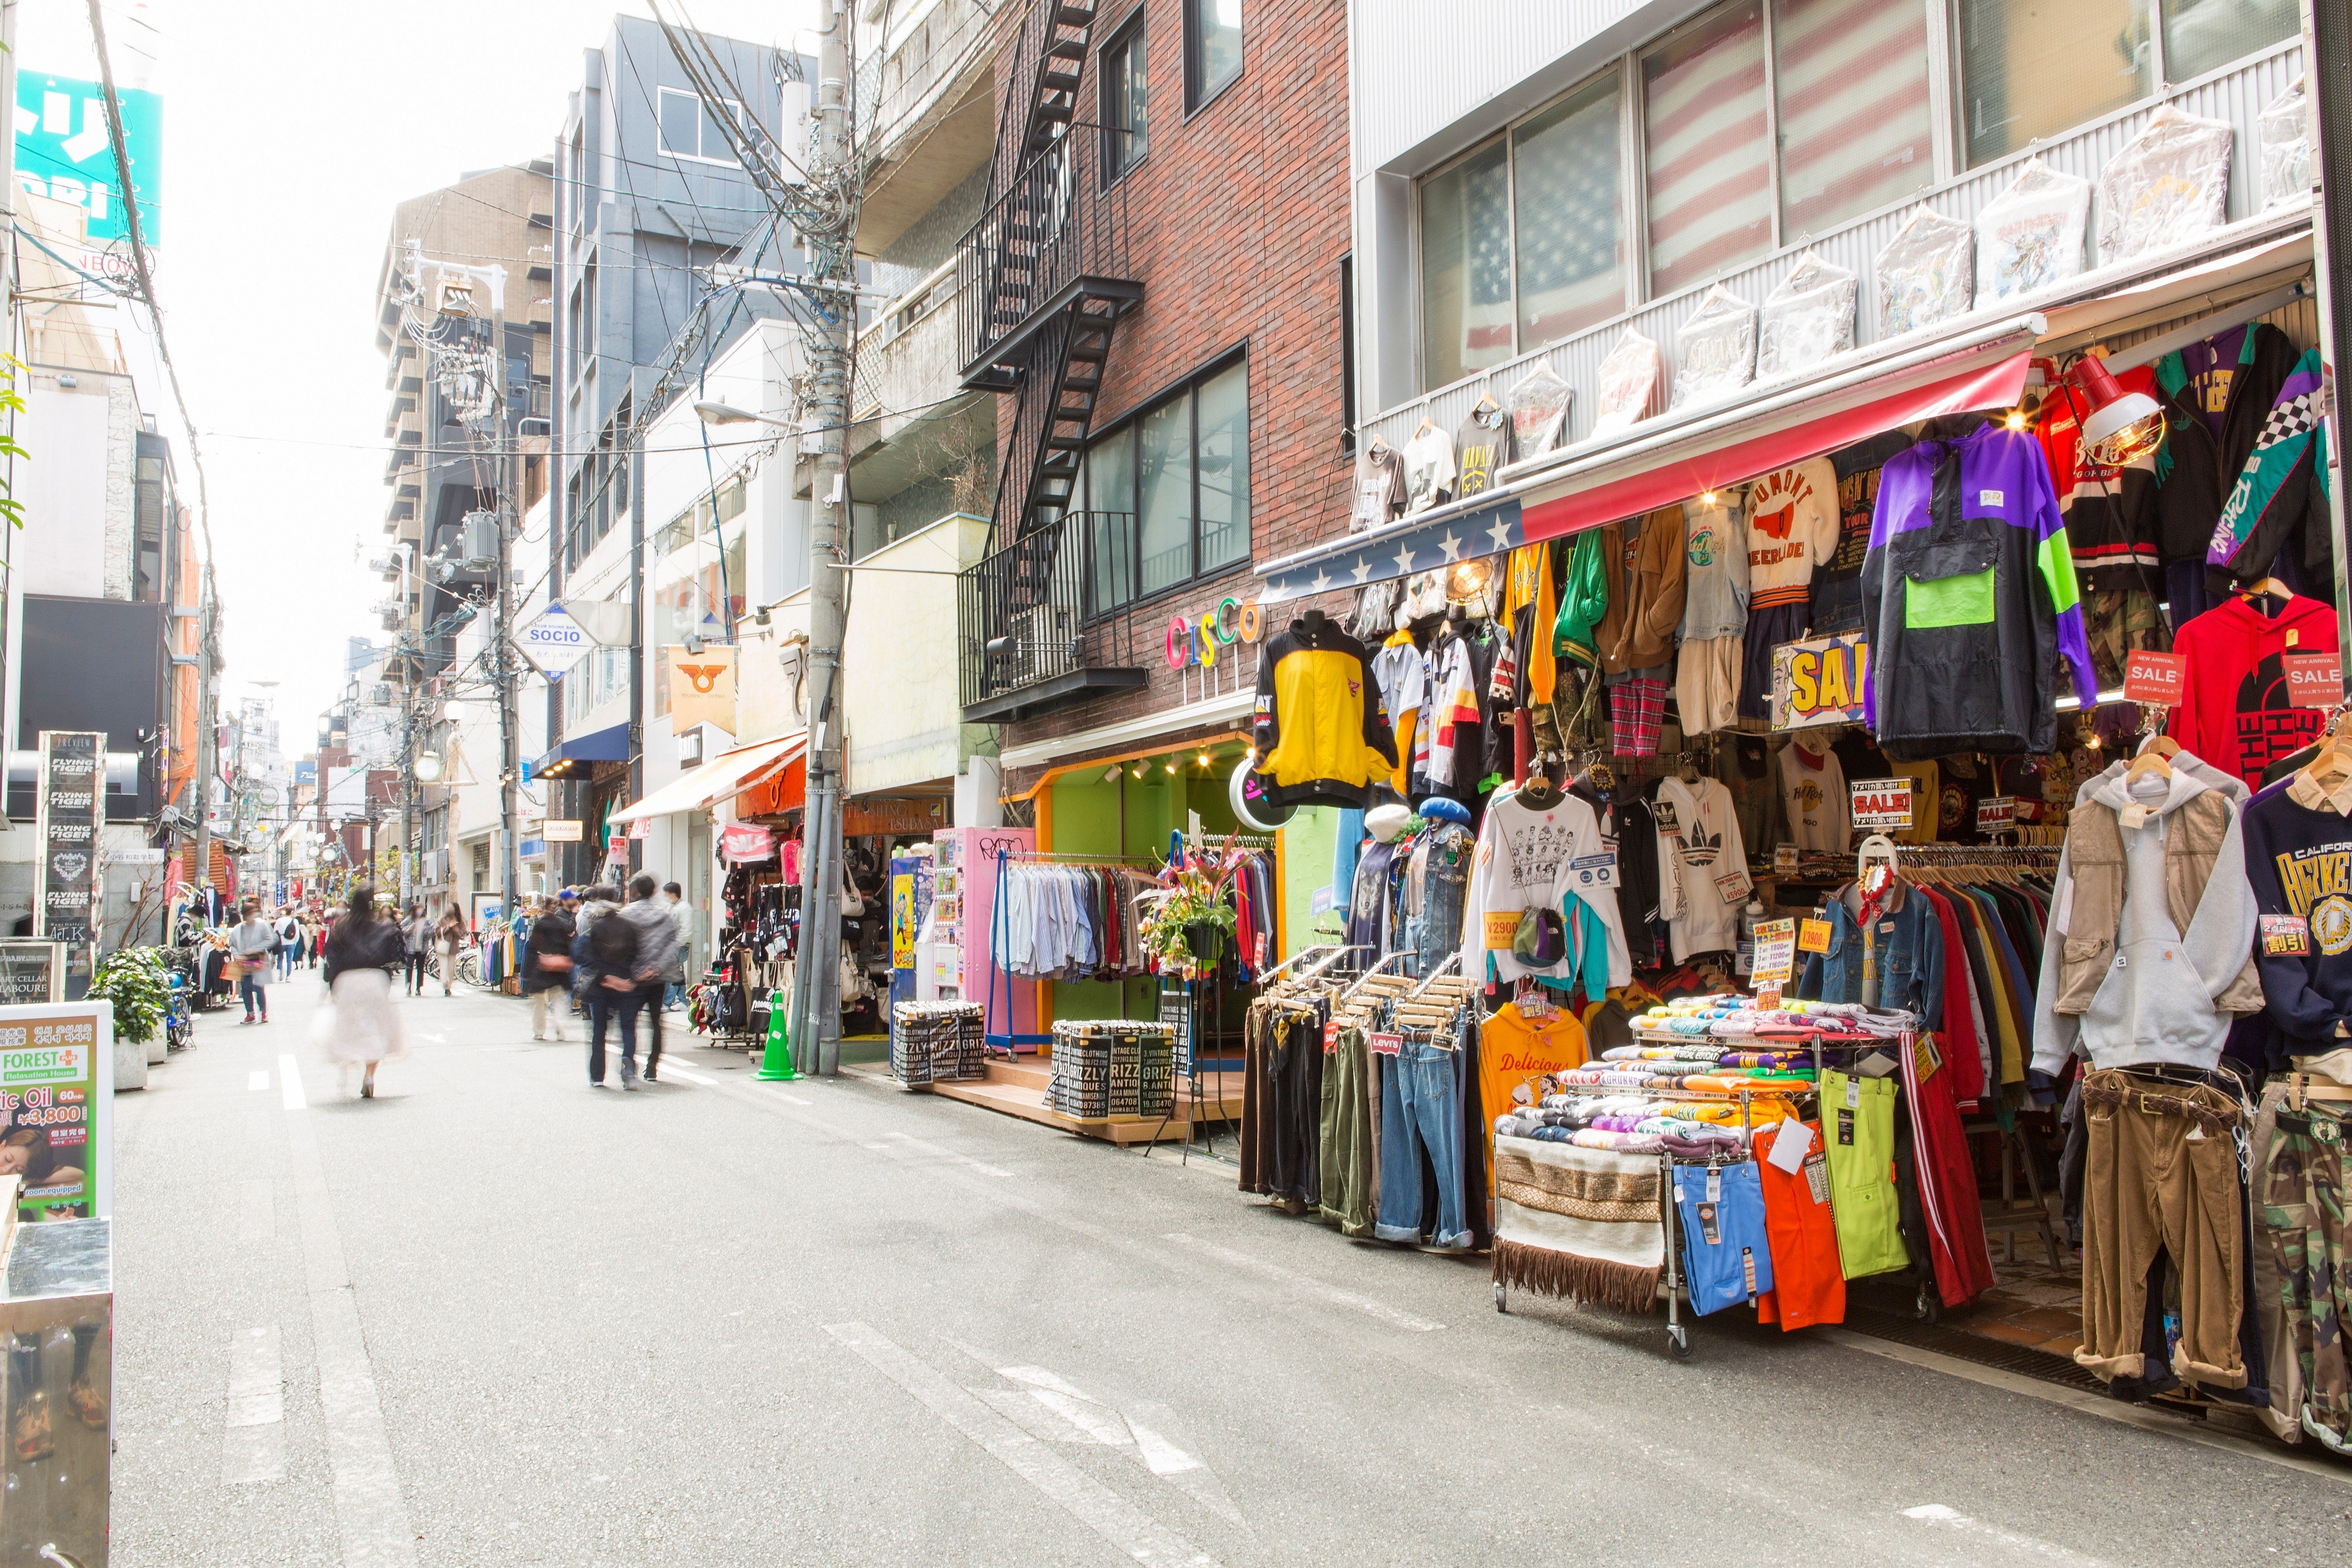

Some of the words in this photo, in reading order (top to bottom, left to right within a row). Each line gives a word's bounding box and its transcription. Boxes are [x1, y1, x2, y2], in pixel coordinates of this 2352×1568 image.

[1845, 512, 1869, 529] TOUR
[531, 630, 580, 642] SOCIO
[1166, 599, 1263, 669] CISCO
[2131, 666, 2176, 683] SALE
[2291, 669, 2342, 684] SALE
[58, 739, 91, 747] PREVIEW
[2237, 715, 2265, 781] THE
[1854, 781, 1909, 790] アメリカ買い付け古着
[1854, 793, 1910, 814] SALE!
[846, 804, 907, 818] TENSHINO
[1978, 806, 2014, 822] SALE!
[889, 818, 939, 831] TSUBASA
[1660, 822, 1679, 830] adidas
[1855, 816, 1910, 824] アメリカ買い付け古着
[630, 821, 651, 838] SALE
[1726, 888, 1745, 899] ¥5900
[1487, 922, 1517, 934] ¥2900
[1755, 924, 1781, 935] 2枚以上
[2264, 926, 2305, 934] 2点以上で
[1803, 930, 1822, 946] ¥3900
[2267, 934, 2306, 953] 割引
[0, 984, 47, 993] LABOURE
[1759, 982, 1780, 993] SALE!
[1522, 1005, 1546, 1017] 割引
[1758, 1003, 1779, 1011] しました
[56, 1025, 91, 1034] 오십시오
[65, 1033, 91, 1042] 마사지
[4, 1052, 59, 1069] FOREST
[1500, 1052, 1568, 1071] Delicious
[6, 1071, 47, 1080] Relaxation
[1070, 1065, 1107, 1081] GRIZZLY
[1919, 1064, 1935, 1083] SKIRT
[25, 1088, 51, 1108] Oil
[18, 1106, 80, 1125] ¥3,800
[48, 1185, 81, 1196] equipped
